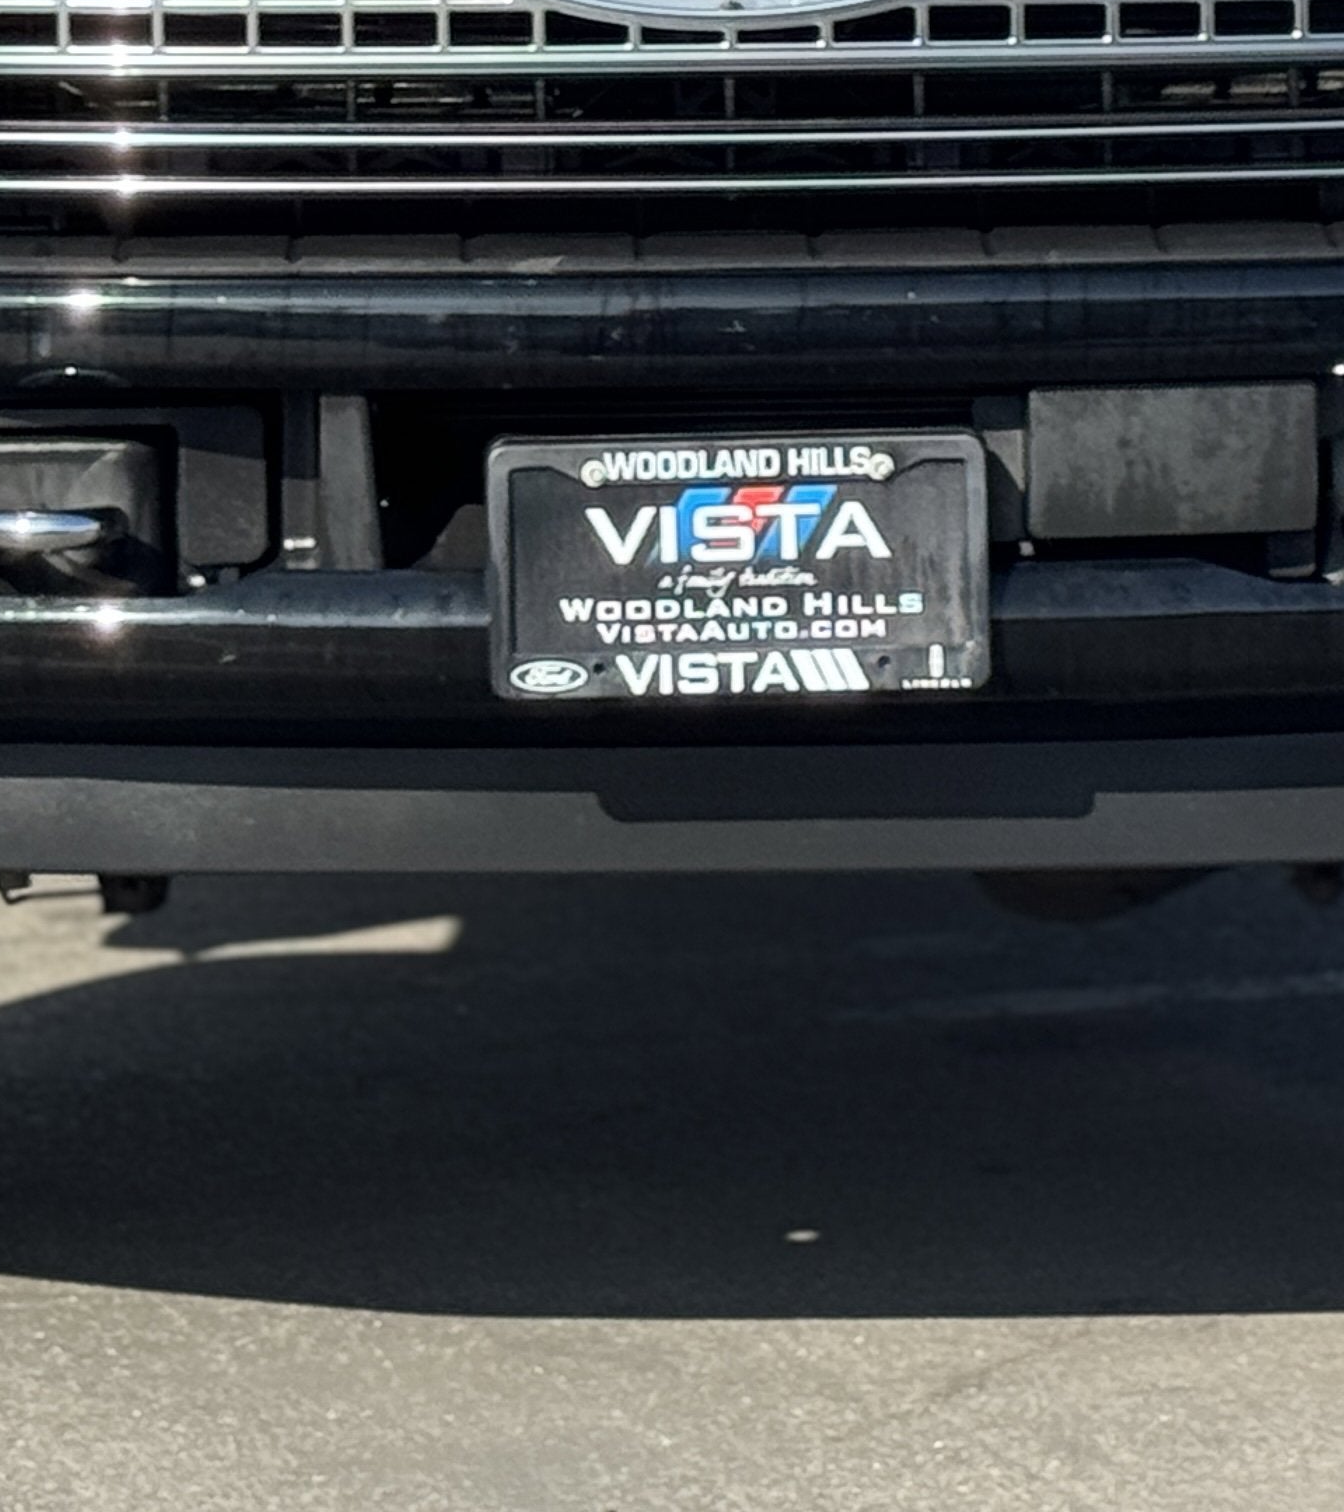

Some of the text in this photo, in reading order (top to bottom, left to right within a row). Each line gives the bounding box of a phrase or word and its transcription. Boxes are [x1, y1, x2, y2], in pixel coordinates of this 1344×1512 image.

[603, 446, 872, 481] WOODLAND HILLS
[584, 501, 893, 566] VISTA
[559, 591, 923, 622] WOODLAND HILLS
[615, 650, 800, 696] VISTA
